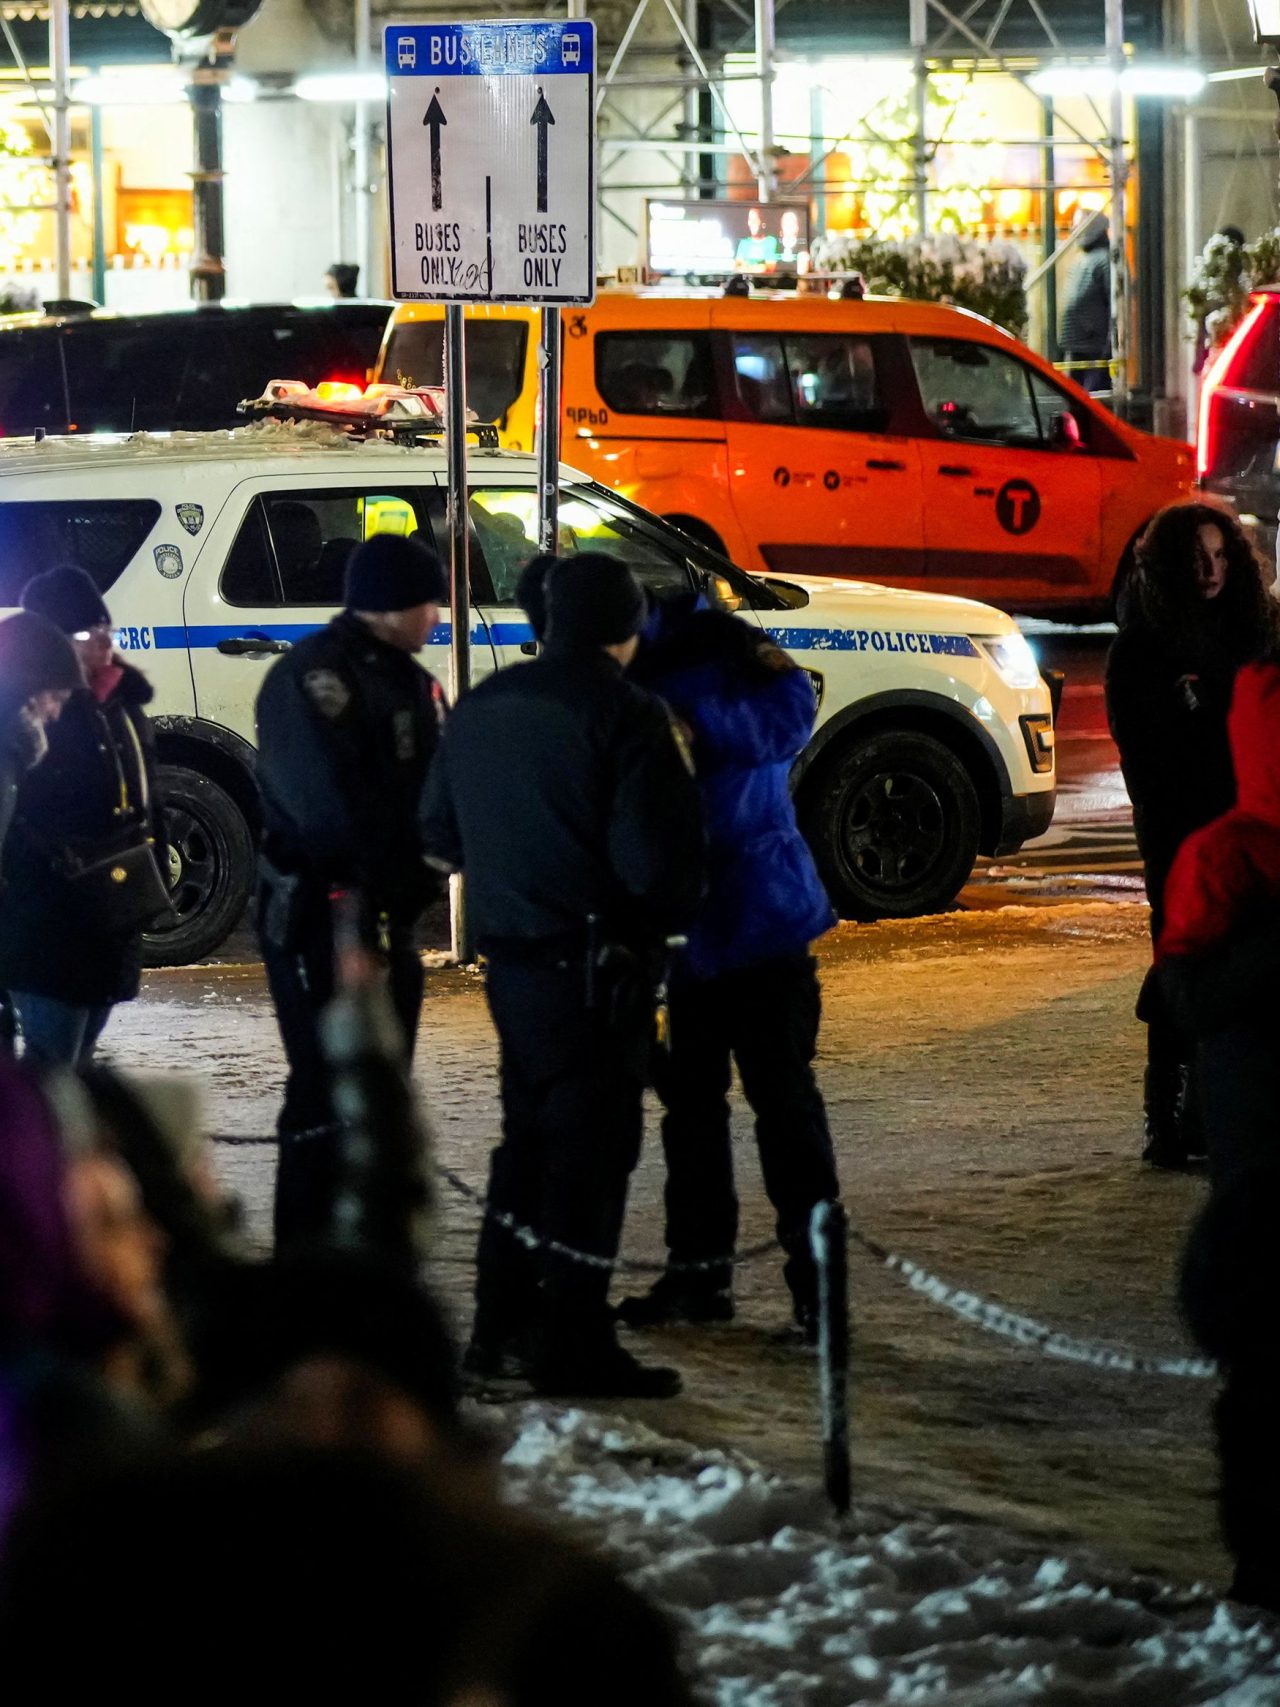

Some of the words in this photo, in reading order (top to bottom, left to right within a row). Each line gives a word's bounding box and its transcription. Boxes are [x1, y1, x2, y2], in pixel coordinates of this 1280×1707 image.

[430, 35, 471, 66] BUS
[415, 222, 461, 252] BUSES
[518, 223, 567, 254] BUSES
[421, 256, 458, 286] ONLY
[523, 257, 562, 288] ONLY
[1006, 488, 1032, 529] T
[119, 626, 151, 650] CRC
[855, 629, 931, 654] POLICE
